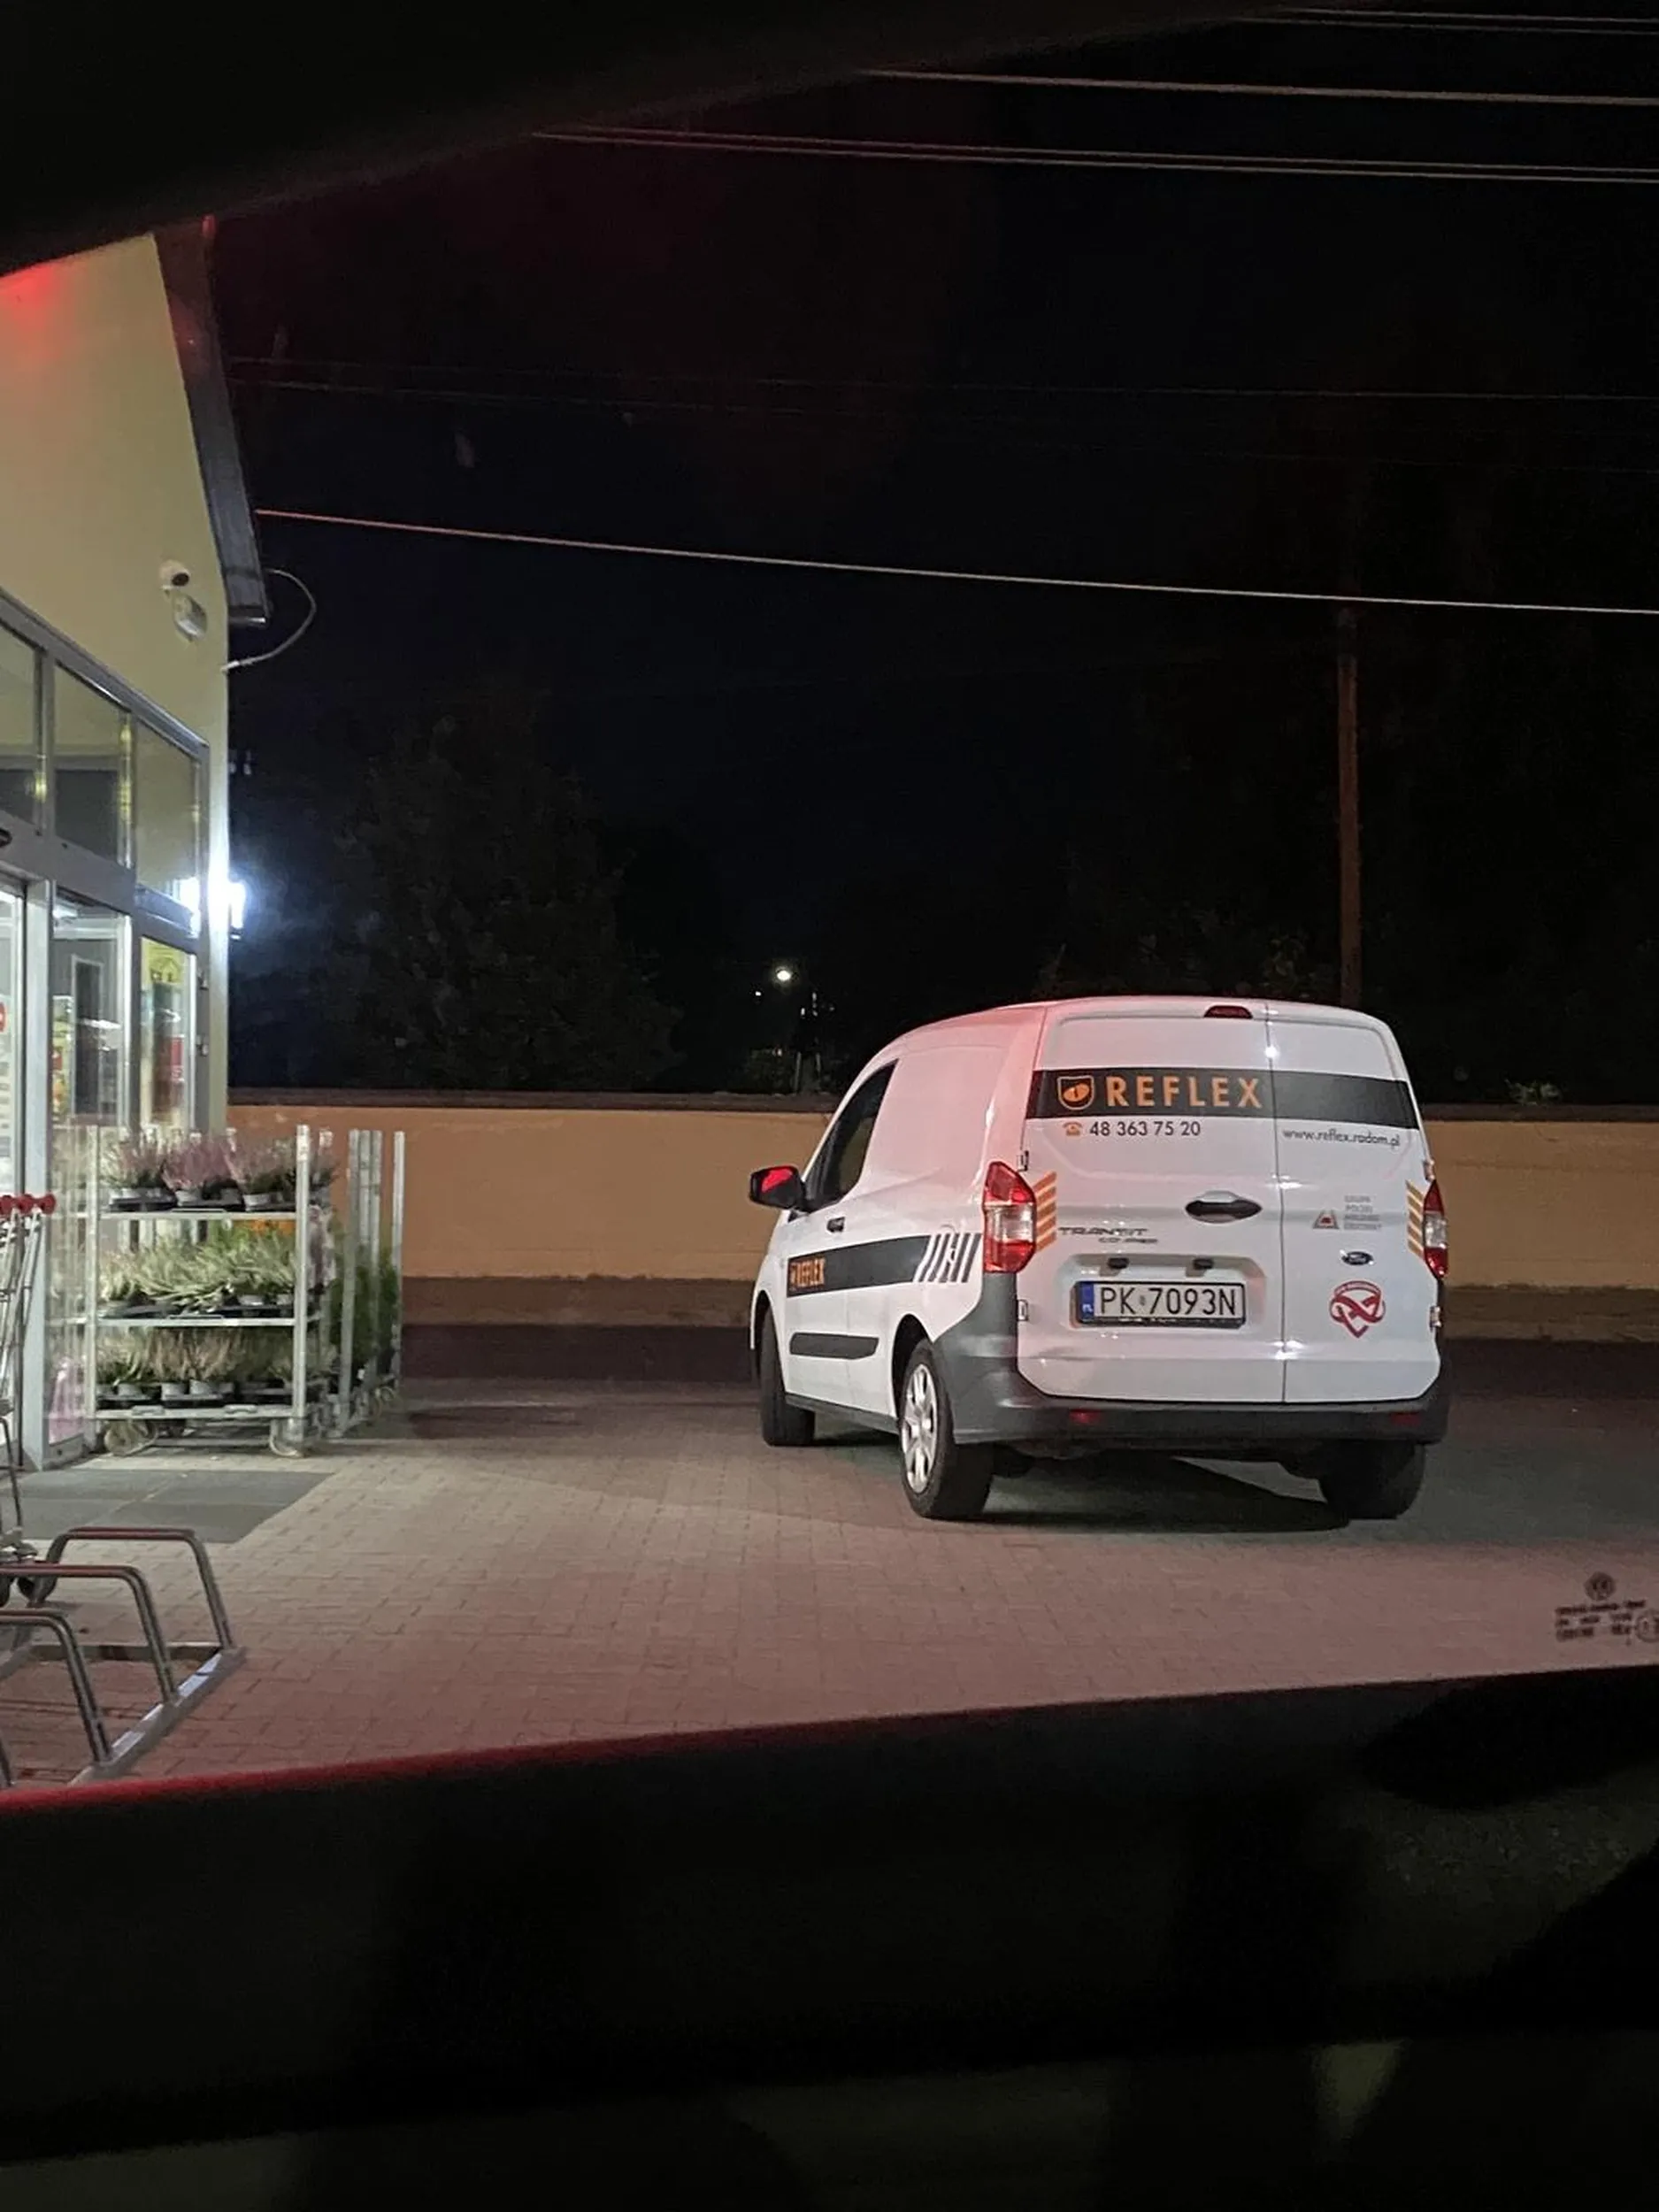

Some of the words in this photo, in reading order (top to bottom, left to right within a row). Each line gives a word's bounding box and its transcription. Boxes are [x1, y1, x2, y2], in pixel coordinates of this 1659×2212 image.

[1106, 1075, 1262, 1109] REFLEX
[1089, 1120, 1110, 1136] 48
[1117, 1120, 1148, 1136] 363
[1154, 1120, 1174, 1136] 75
[1180, 1120, 1201, 1136] 20
[1100, 1286, 1136, 1315] PK
[1148, 1286, 1236, 1316] 7093N
